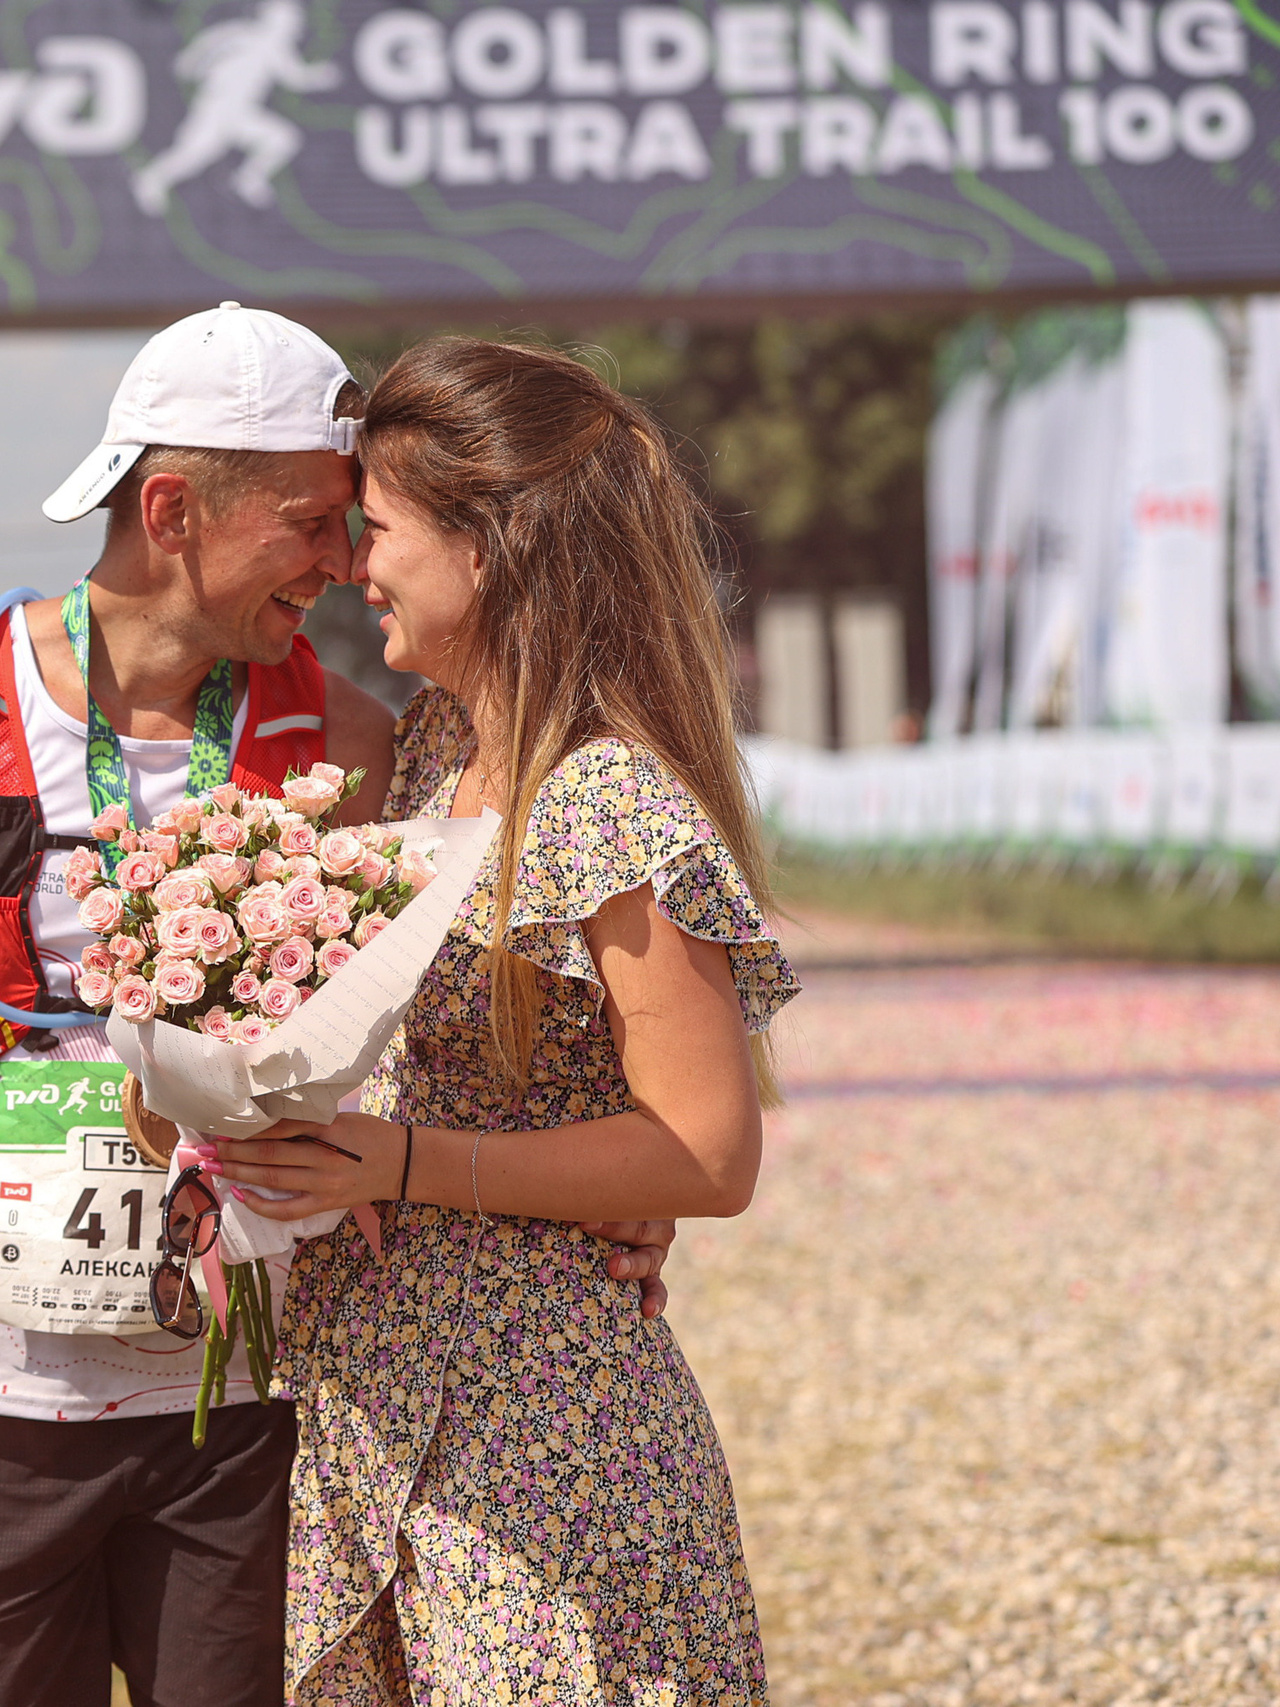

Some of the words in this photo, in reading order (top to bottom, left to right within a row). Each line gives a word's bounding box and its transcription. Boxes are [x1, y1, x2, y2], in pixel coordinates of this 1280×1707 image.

[354, 2, 893, 98] GOLDEN
[930, 0, 1248, 84] RING
[355, 101, 712, 187] ULTRA
[723, 92, 1052, 179] TRAIL
[1058, 84, 1254, 163] 100
[34, 882, 63, 895] ORLD
[103, 1141, 151, 1166] T5
[60, 1258, 187, 1278] АЛЕКСАН
